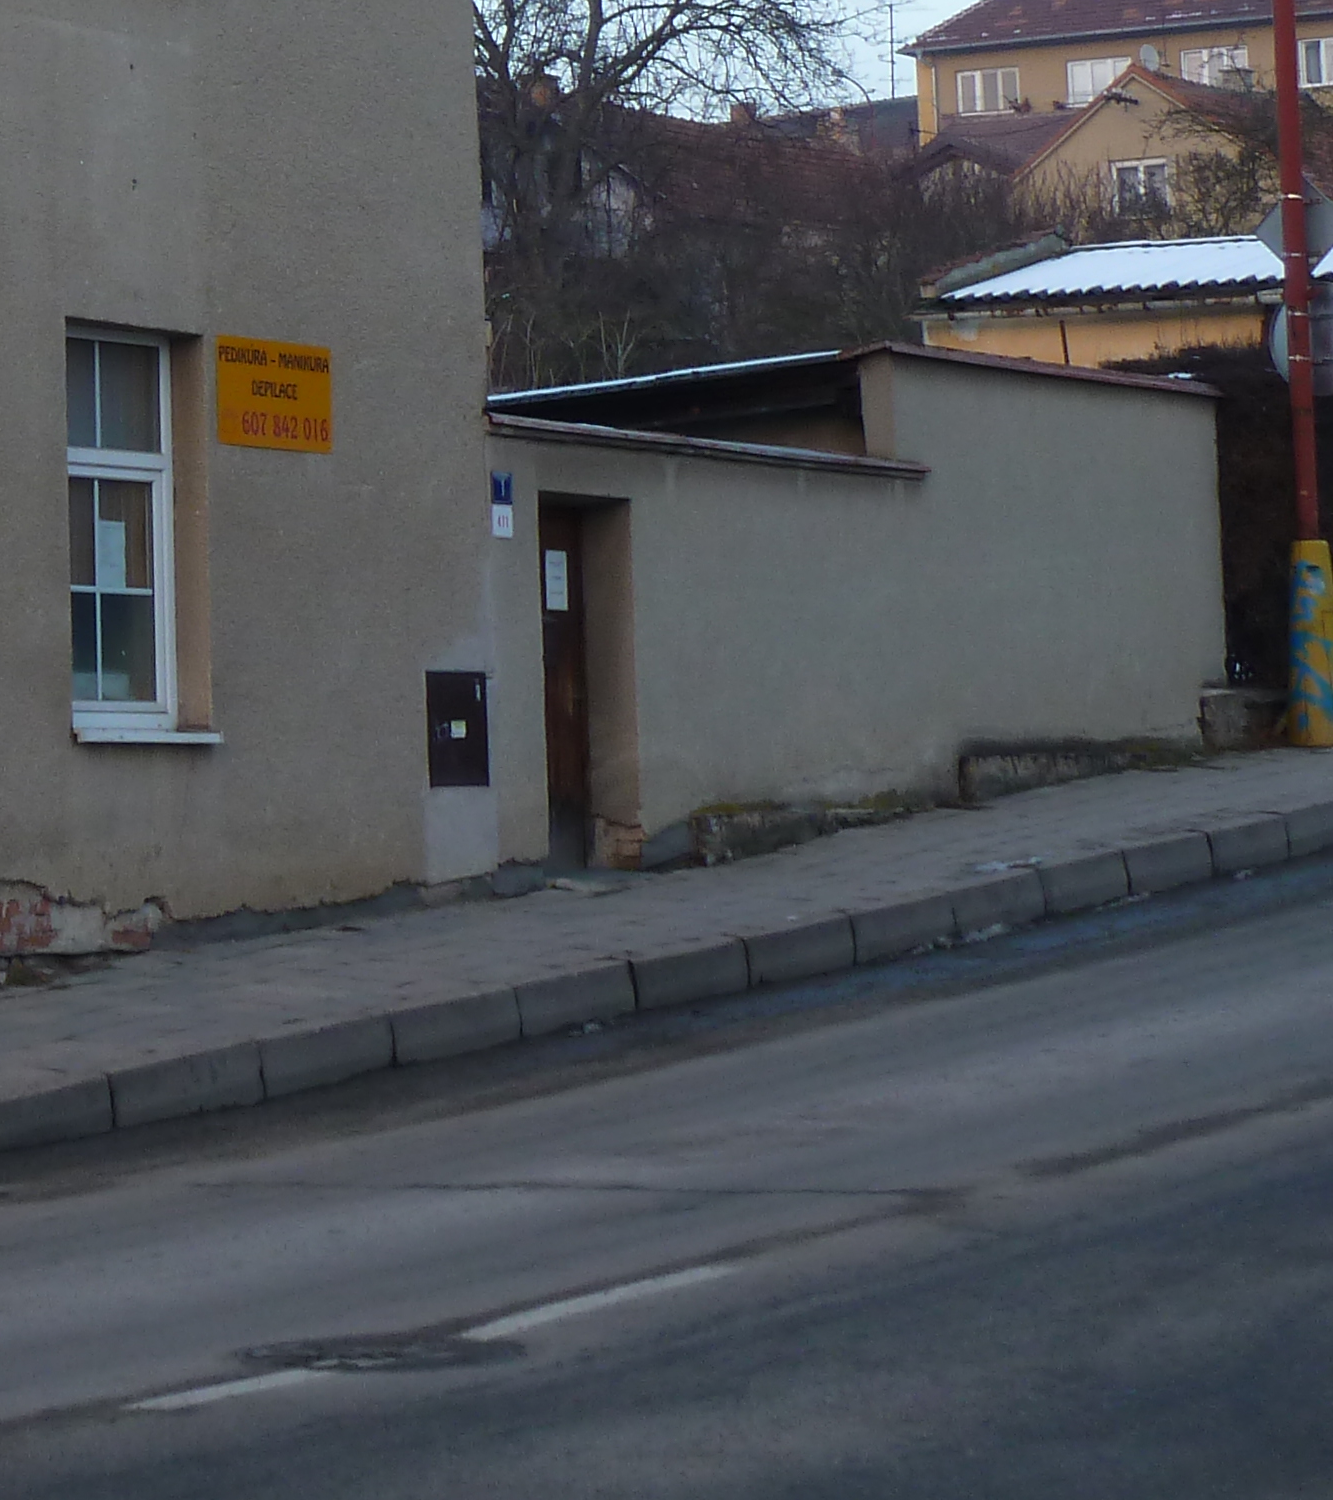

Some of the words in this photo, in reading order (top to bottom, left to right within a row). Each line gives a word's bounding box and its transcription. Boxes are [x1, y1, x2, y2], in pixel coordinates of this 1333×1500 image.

[251, 380, 298, 401] DEPILACE
[241, 411, 268, 437] 607
[272, 414, 299, 440] 842
[303, 417, 329, 443] 016
